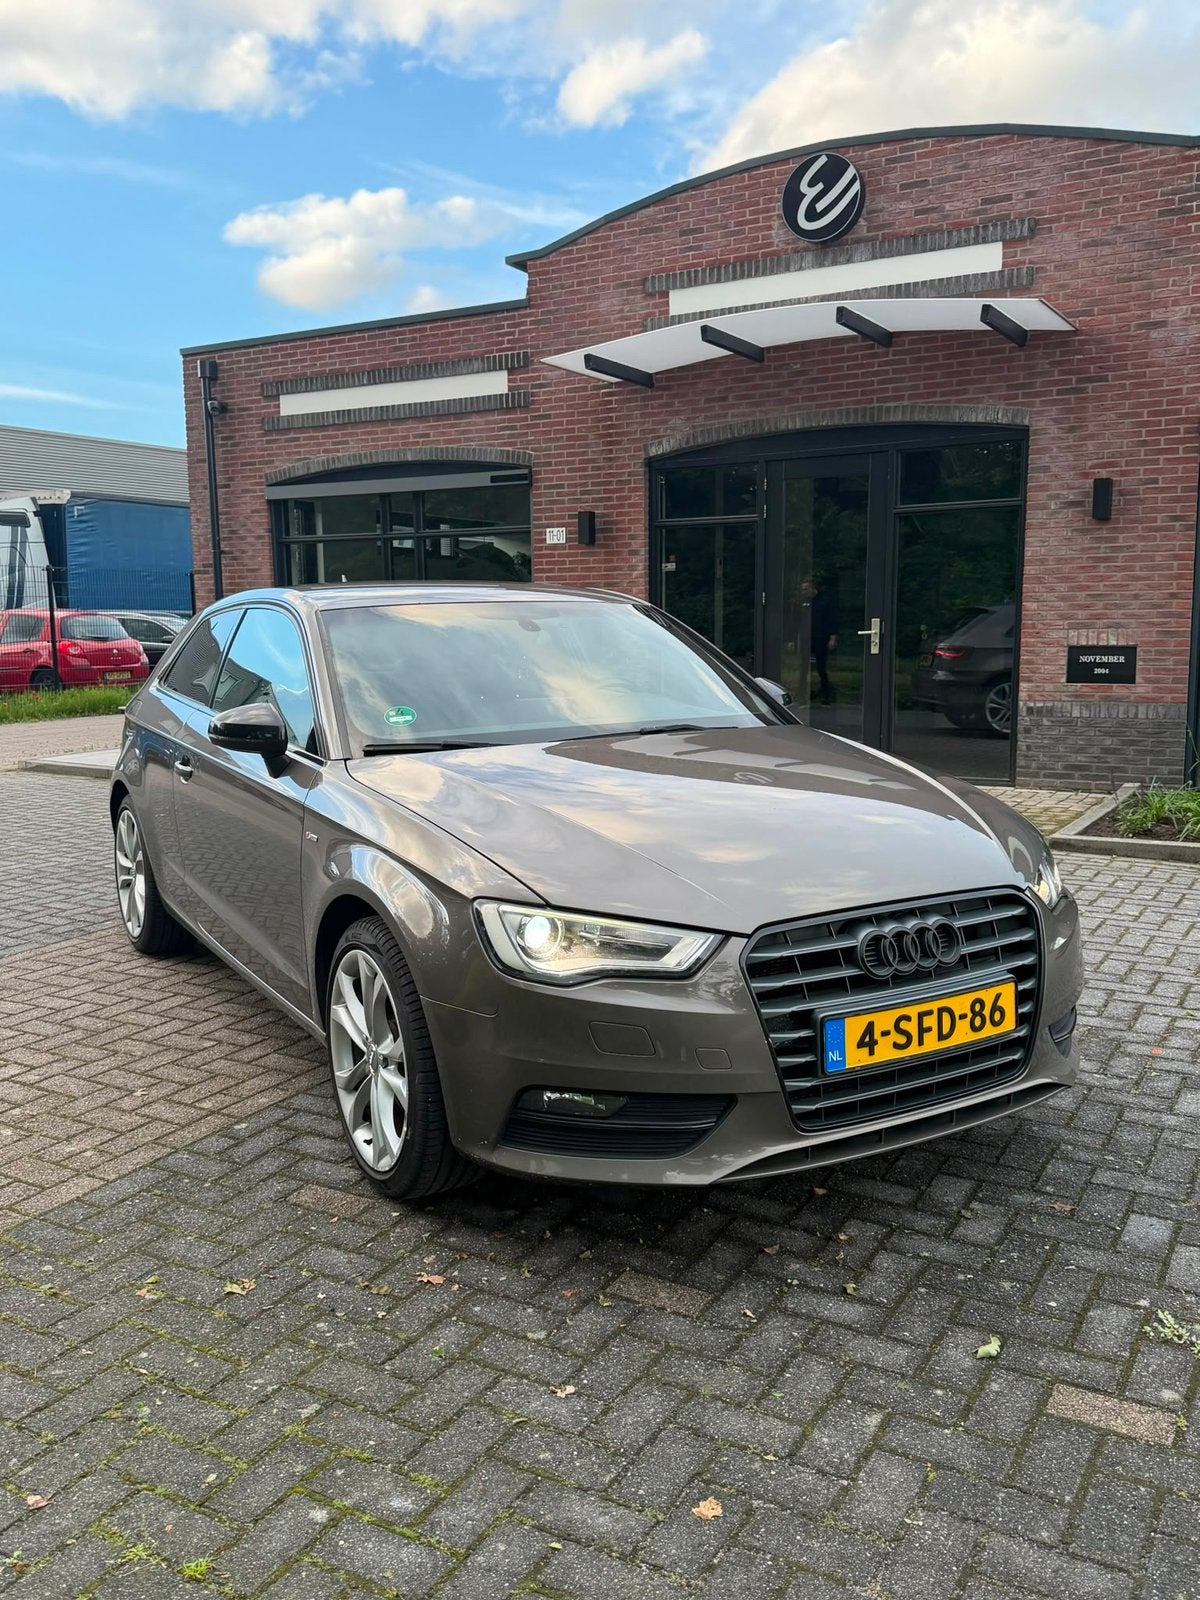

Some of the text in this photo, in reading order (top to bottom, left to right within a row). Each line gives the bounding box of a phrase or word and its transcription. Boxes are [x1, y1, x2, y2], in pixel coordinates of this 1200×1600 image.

[548, 529, 565, 542] 11-01
[1079, 655, 1126, 663] NOVEMBER
[856, 992, 1007, 1057] 4-SFD-86
[828, 1051, 843, 1063] NL
